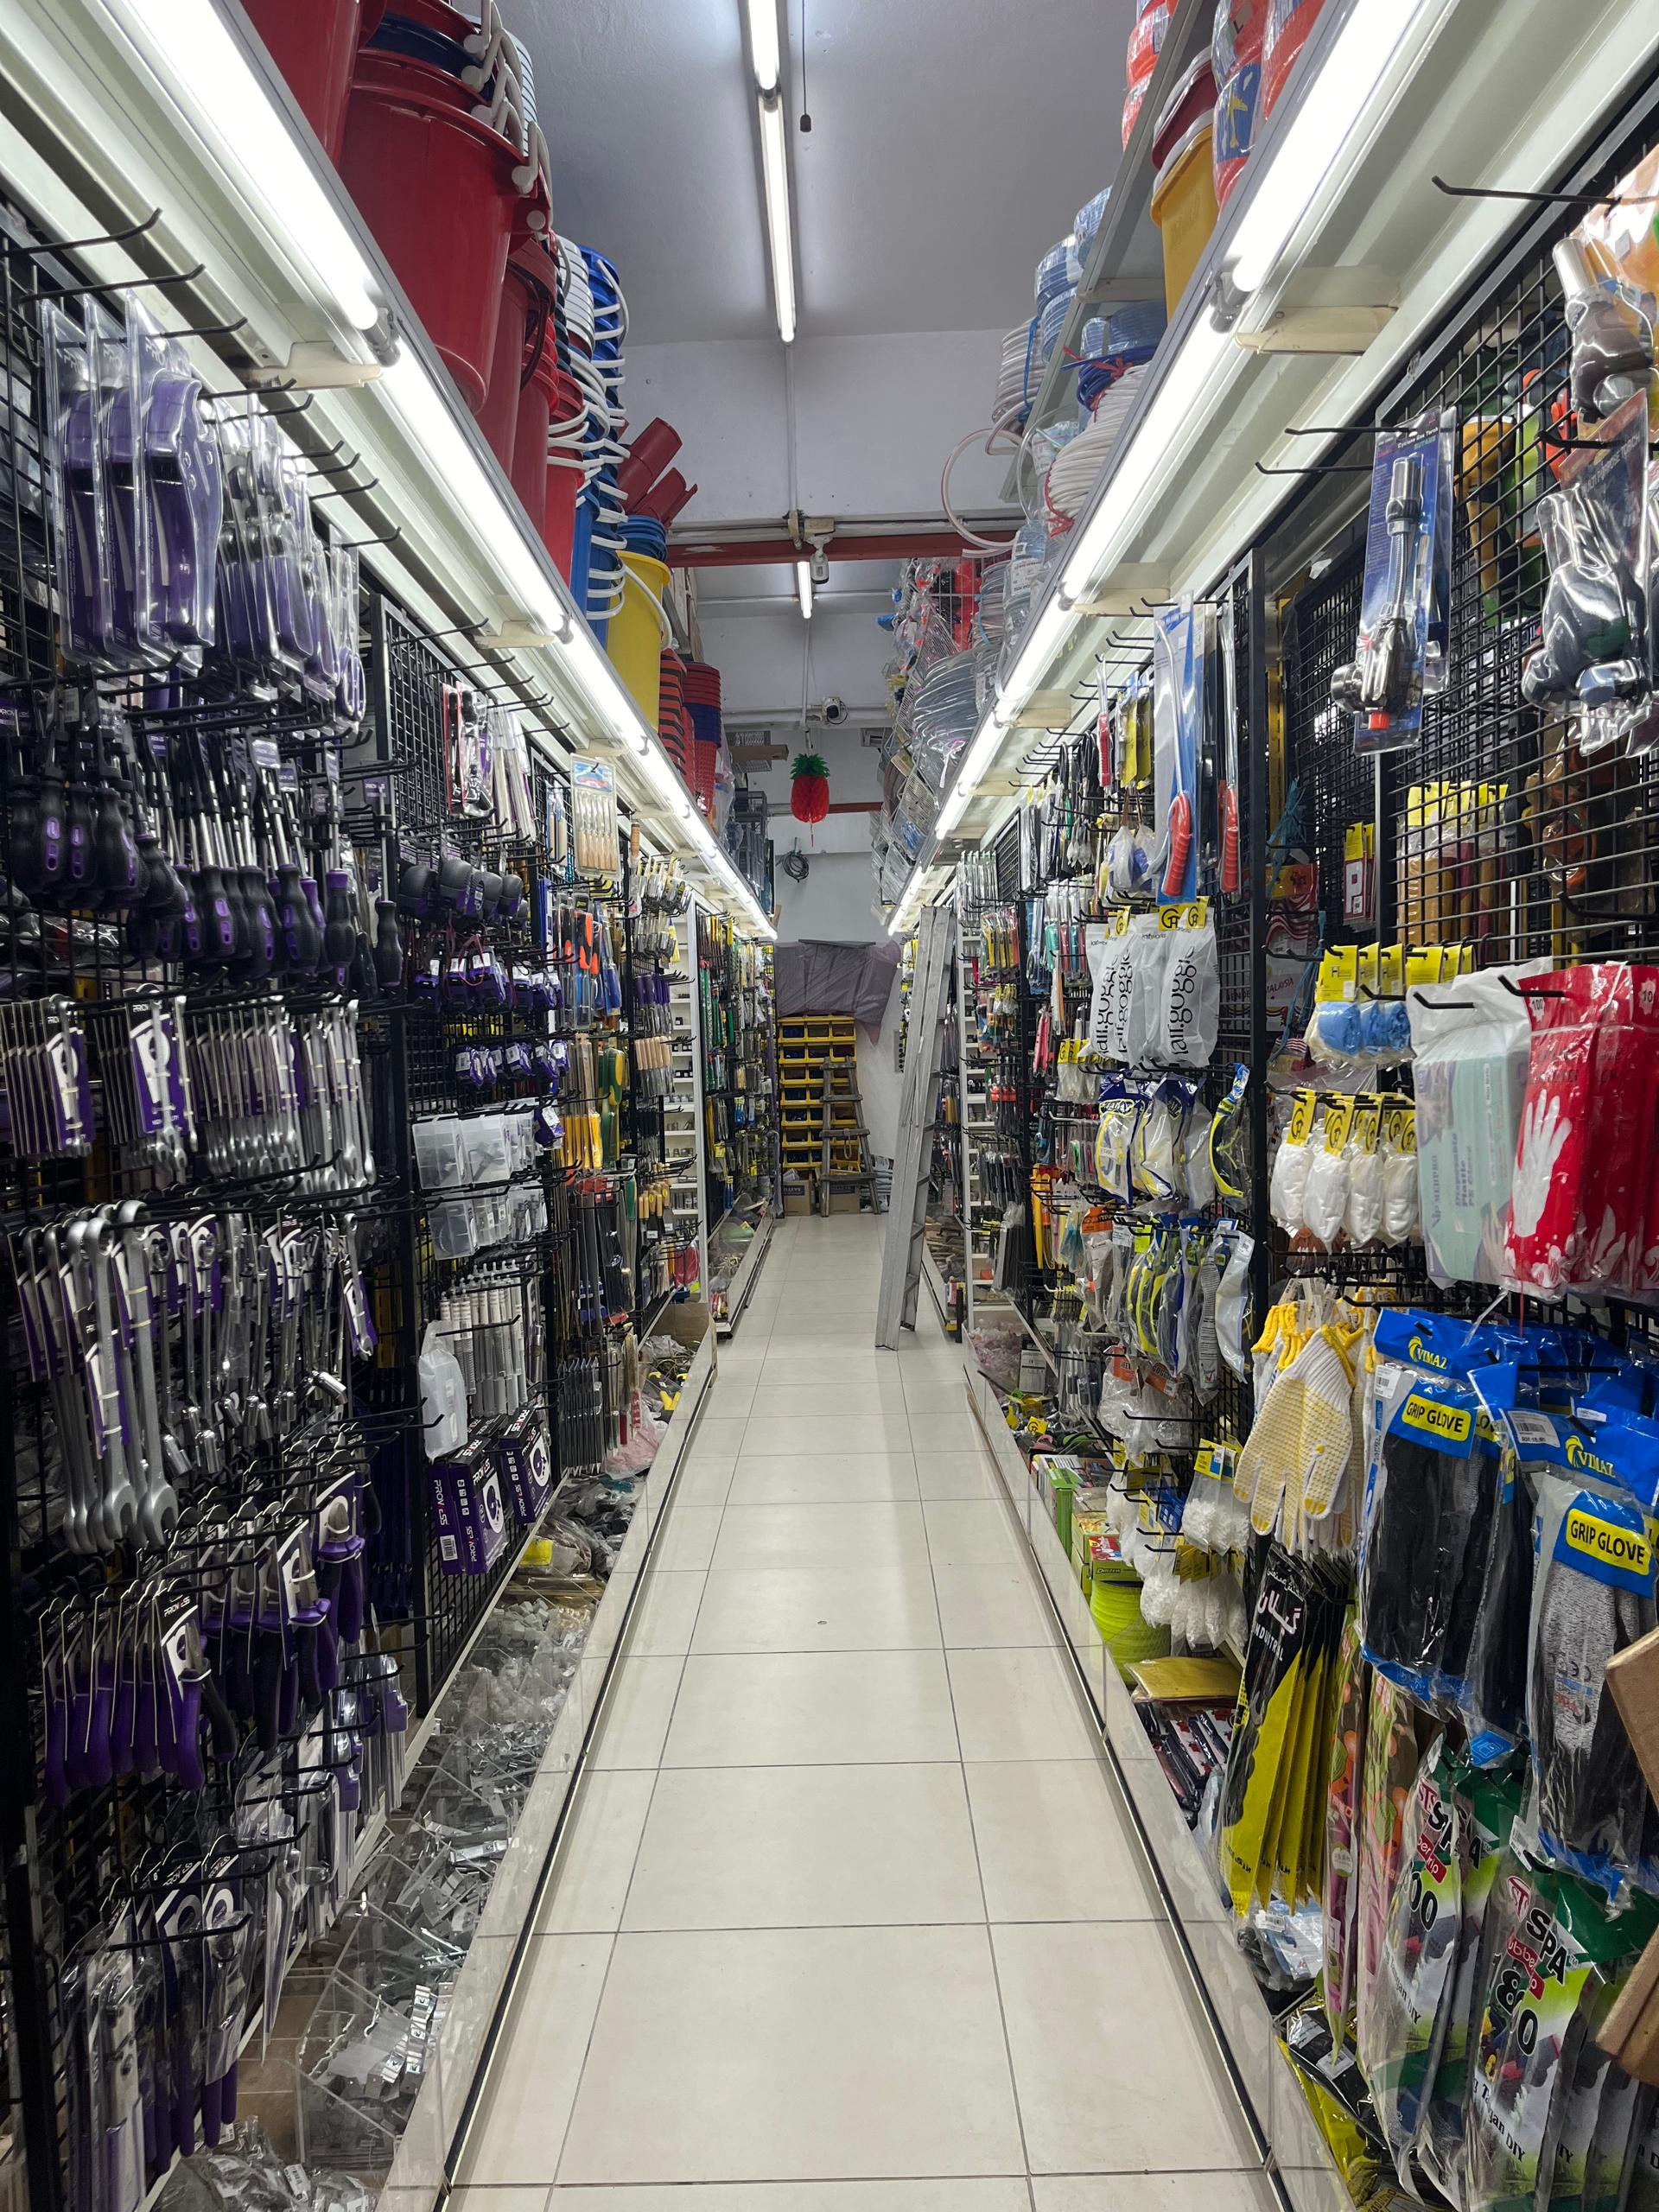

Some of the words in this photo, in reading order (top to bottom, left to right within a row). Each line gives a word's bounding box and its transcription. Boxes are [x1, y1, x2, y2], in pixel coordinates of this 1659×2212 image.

[1531, 999, 1543, 1011] 100
[1406, 1402, 1425, 1420] GRIP
[1427, 1409, 1464, 1433] GLOVE
[1570, 1519, 1596, 1545] GRIP
[1597, 1532, 1646, 1565] GLOVE
[1526, 1908, 1567, 1986] SPA
[1506, 2133, 1526, 2163] DIY
